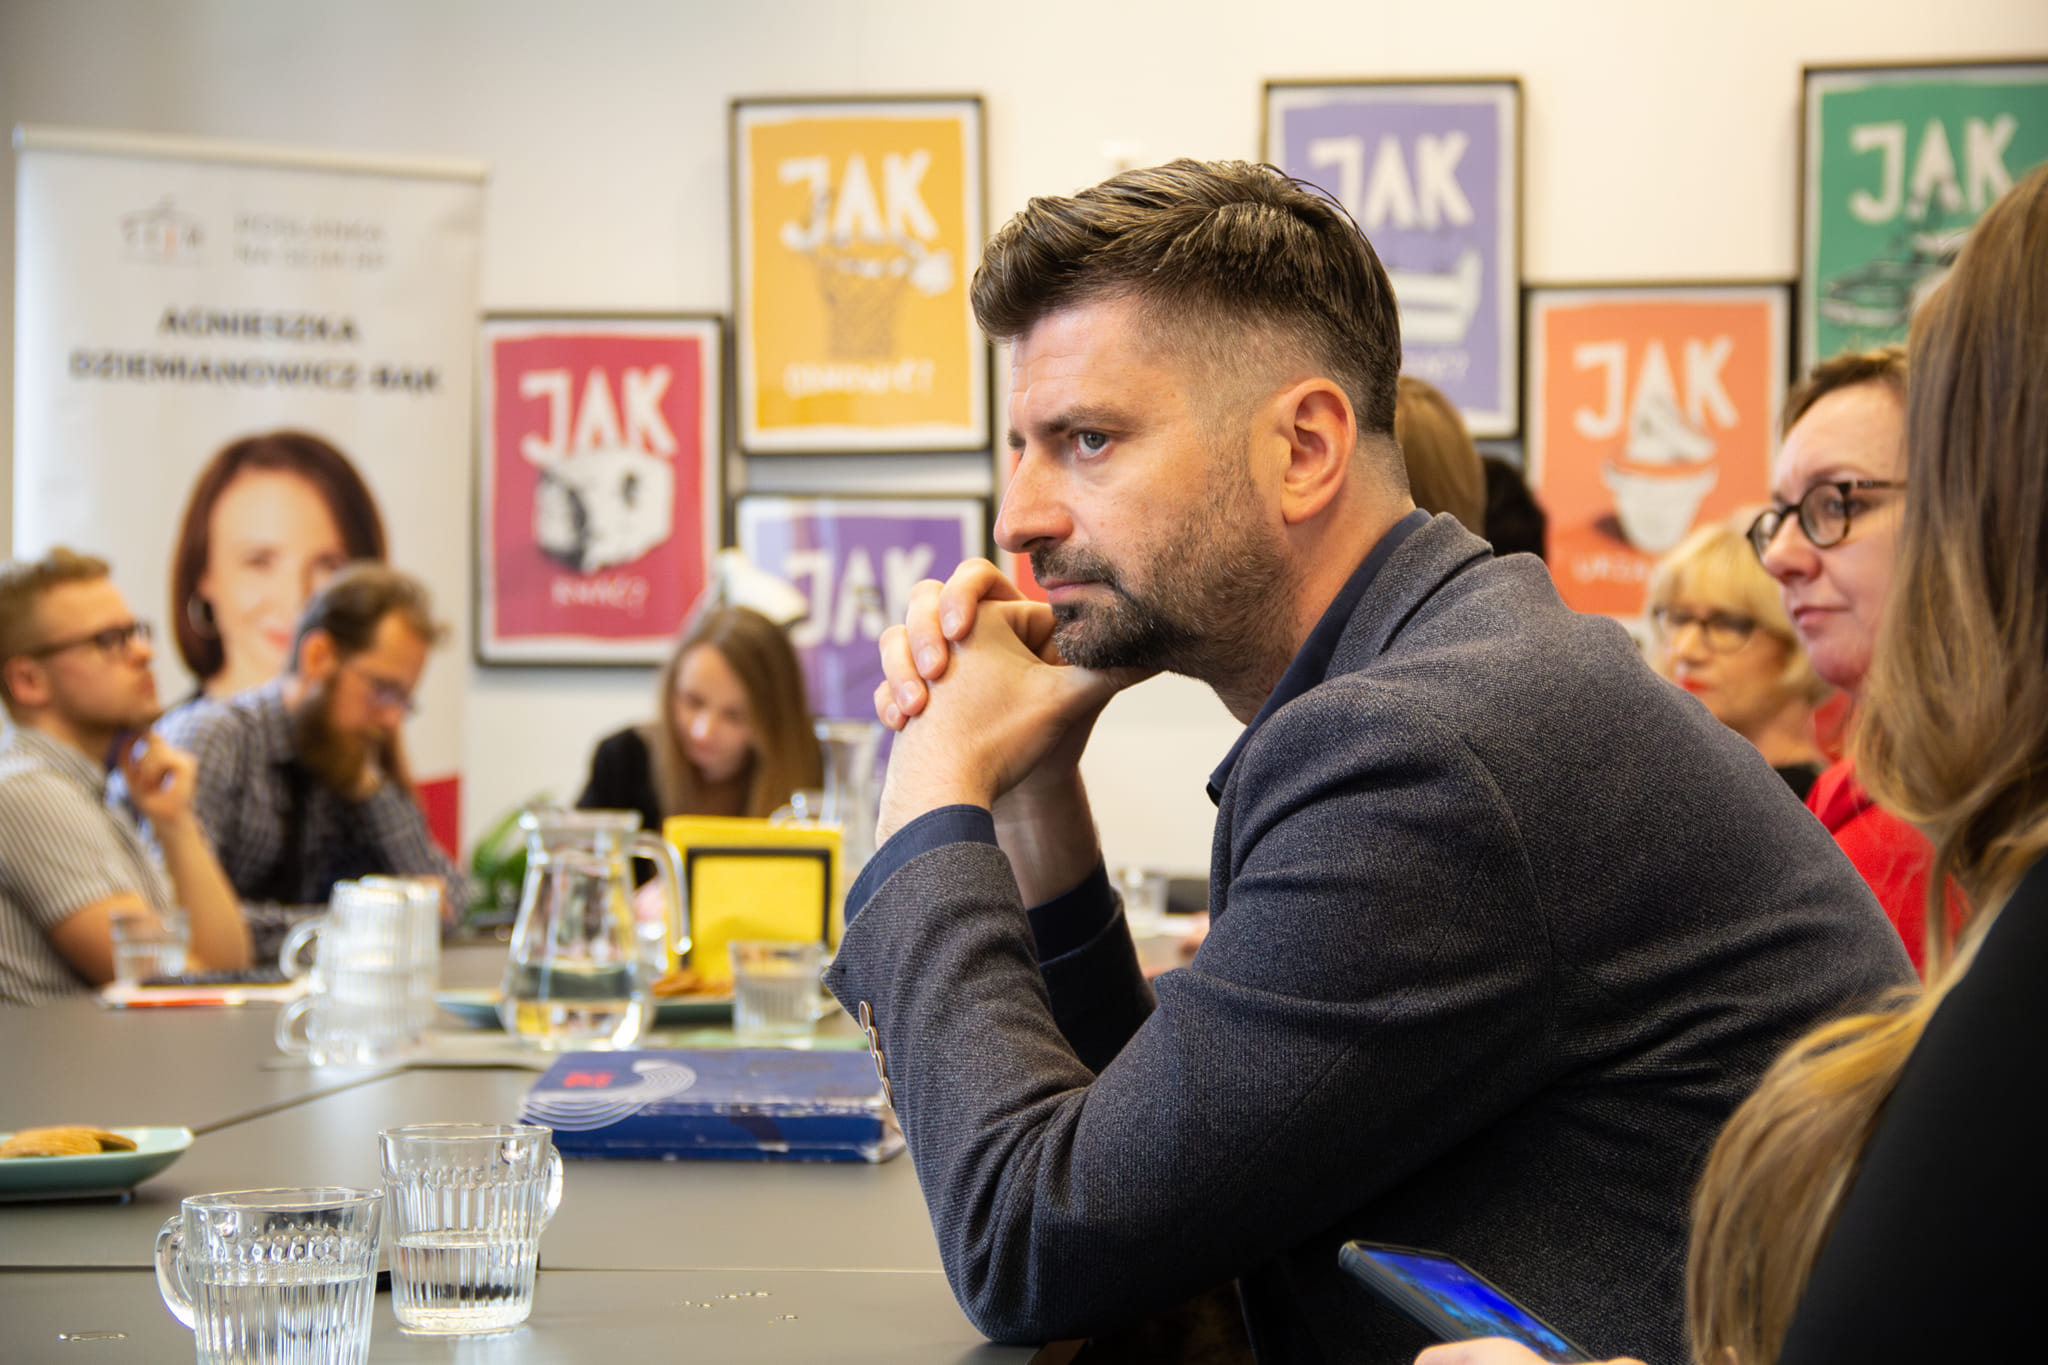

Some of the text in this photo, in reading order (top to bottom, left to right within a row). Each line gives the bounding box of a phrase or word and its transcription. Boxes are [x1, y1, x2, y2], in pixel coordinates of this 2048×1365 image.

[778, 150, 939, 253] JAK
[1309, 131, 1474, 231] JAK
[1850, 115, 2018, 224] JAK
[520, 366, 678, 466] JAK
[1574, 334, 1739, 442] JAK
[786, 544, 934, 648] JAK
